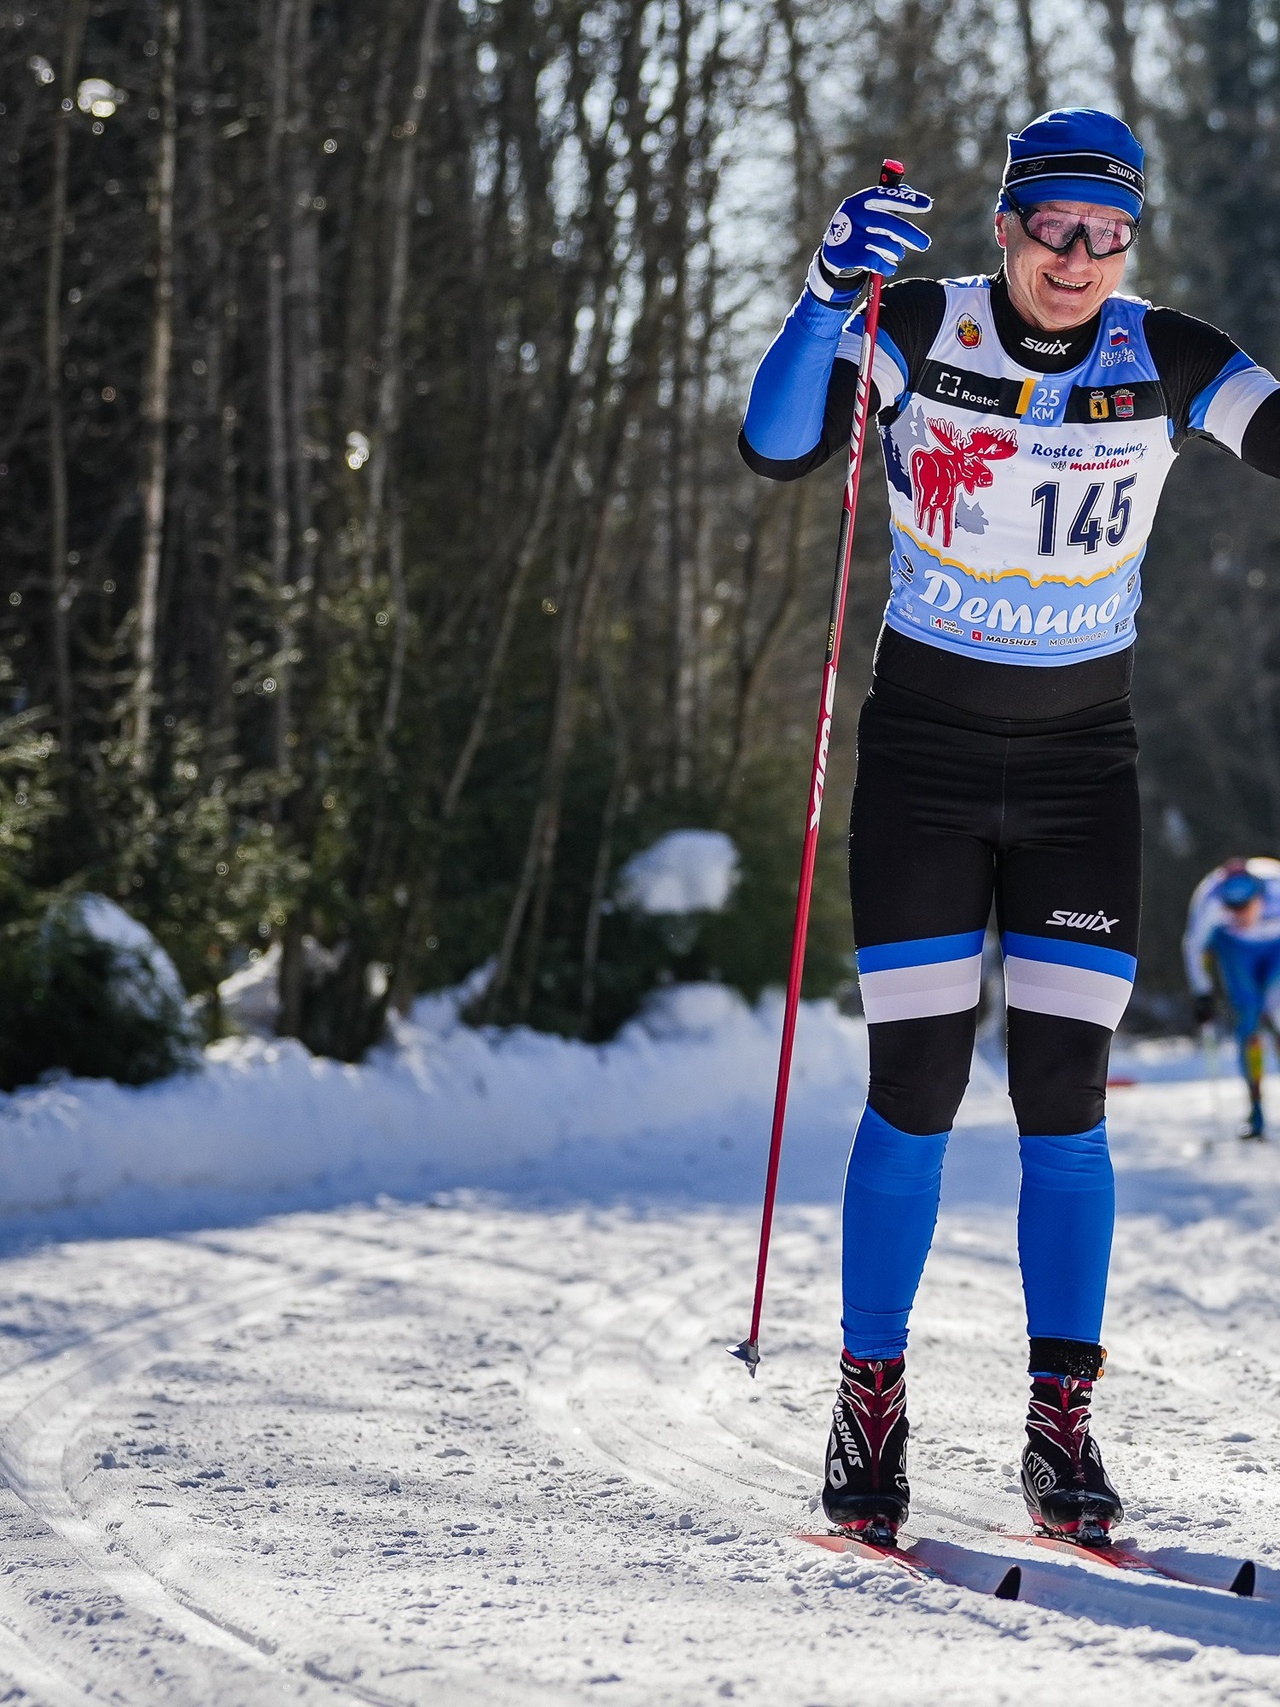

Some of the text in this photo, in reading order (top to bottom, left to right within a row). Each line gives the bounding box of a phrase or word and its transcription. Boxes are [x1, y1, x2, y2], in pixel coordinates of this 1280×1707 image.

[878, 187, 917, 202] COXA
[833, 221, 849, 242] COXA
[961, 390, 1000, 406] Rostec
[1036, 388, 1061, 407] 25
[1031, 407, 1055, 420] KM
[1031, 442, 1143, 458] Rostec Demino
[1069, 458, 1130, 471] marathon
[1030, 472, 1138, 557] 145
[985, 635, 1038, 646] MADSHUS
